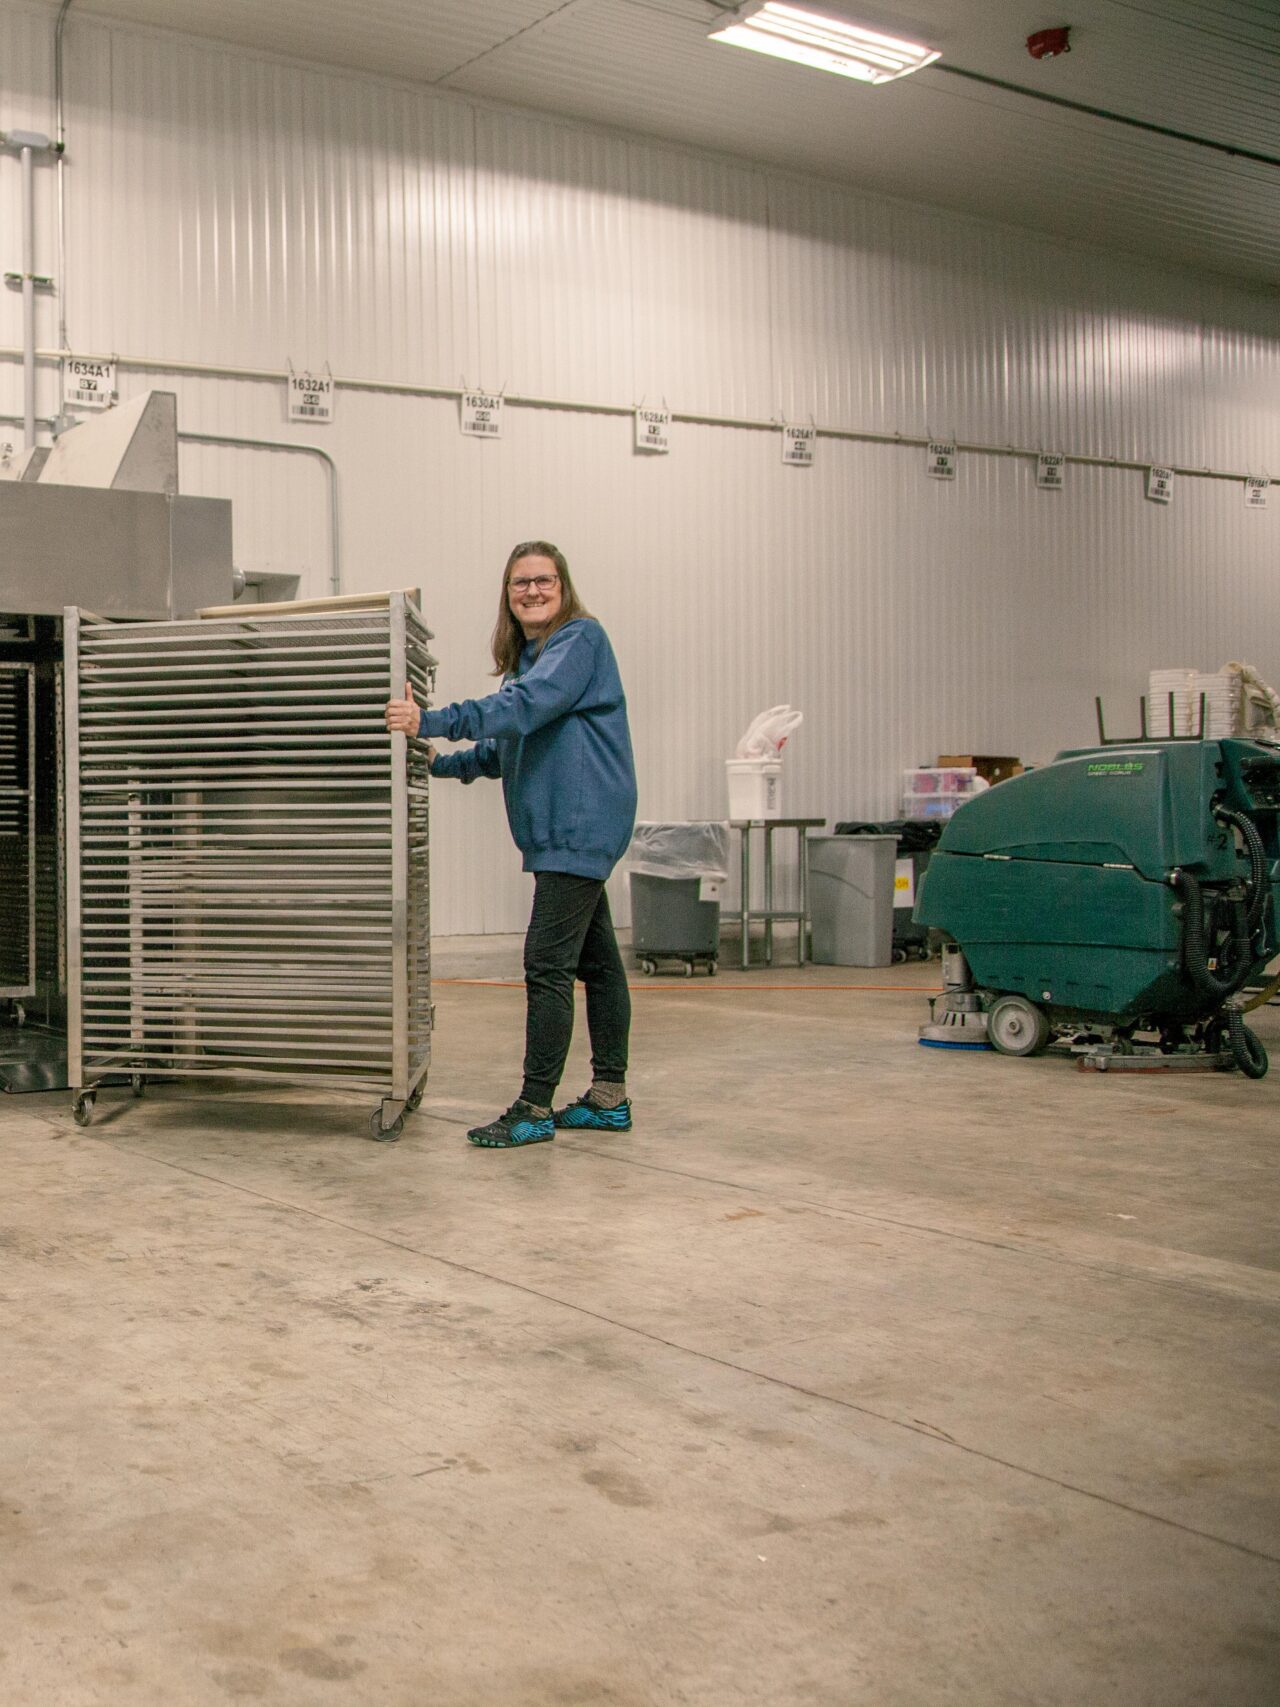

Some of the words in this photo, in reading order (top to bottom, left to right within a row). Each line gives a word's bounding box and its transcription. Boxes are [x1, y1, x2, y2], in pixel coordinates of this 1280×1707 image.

[68, 361, 110, 378] 1634A1
[292, 378, 330, 392] 1632A1
[466, 395, 500, 410] 1630A1
